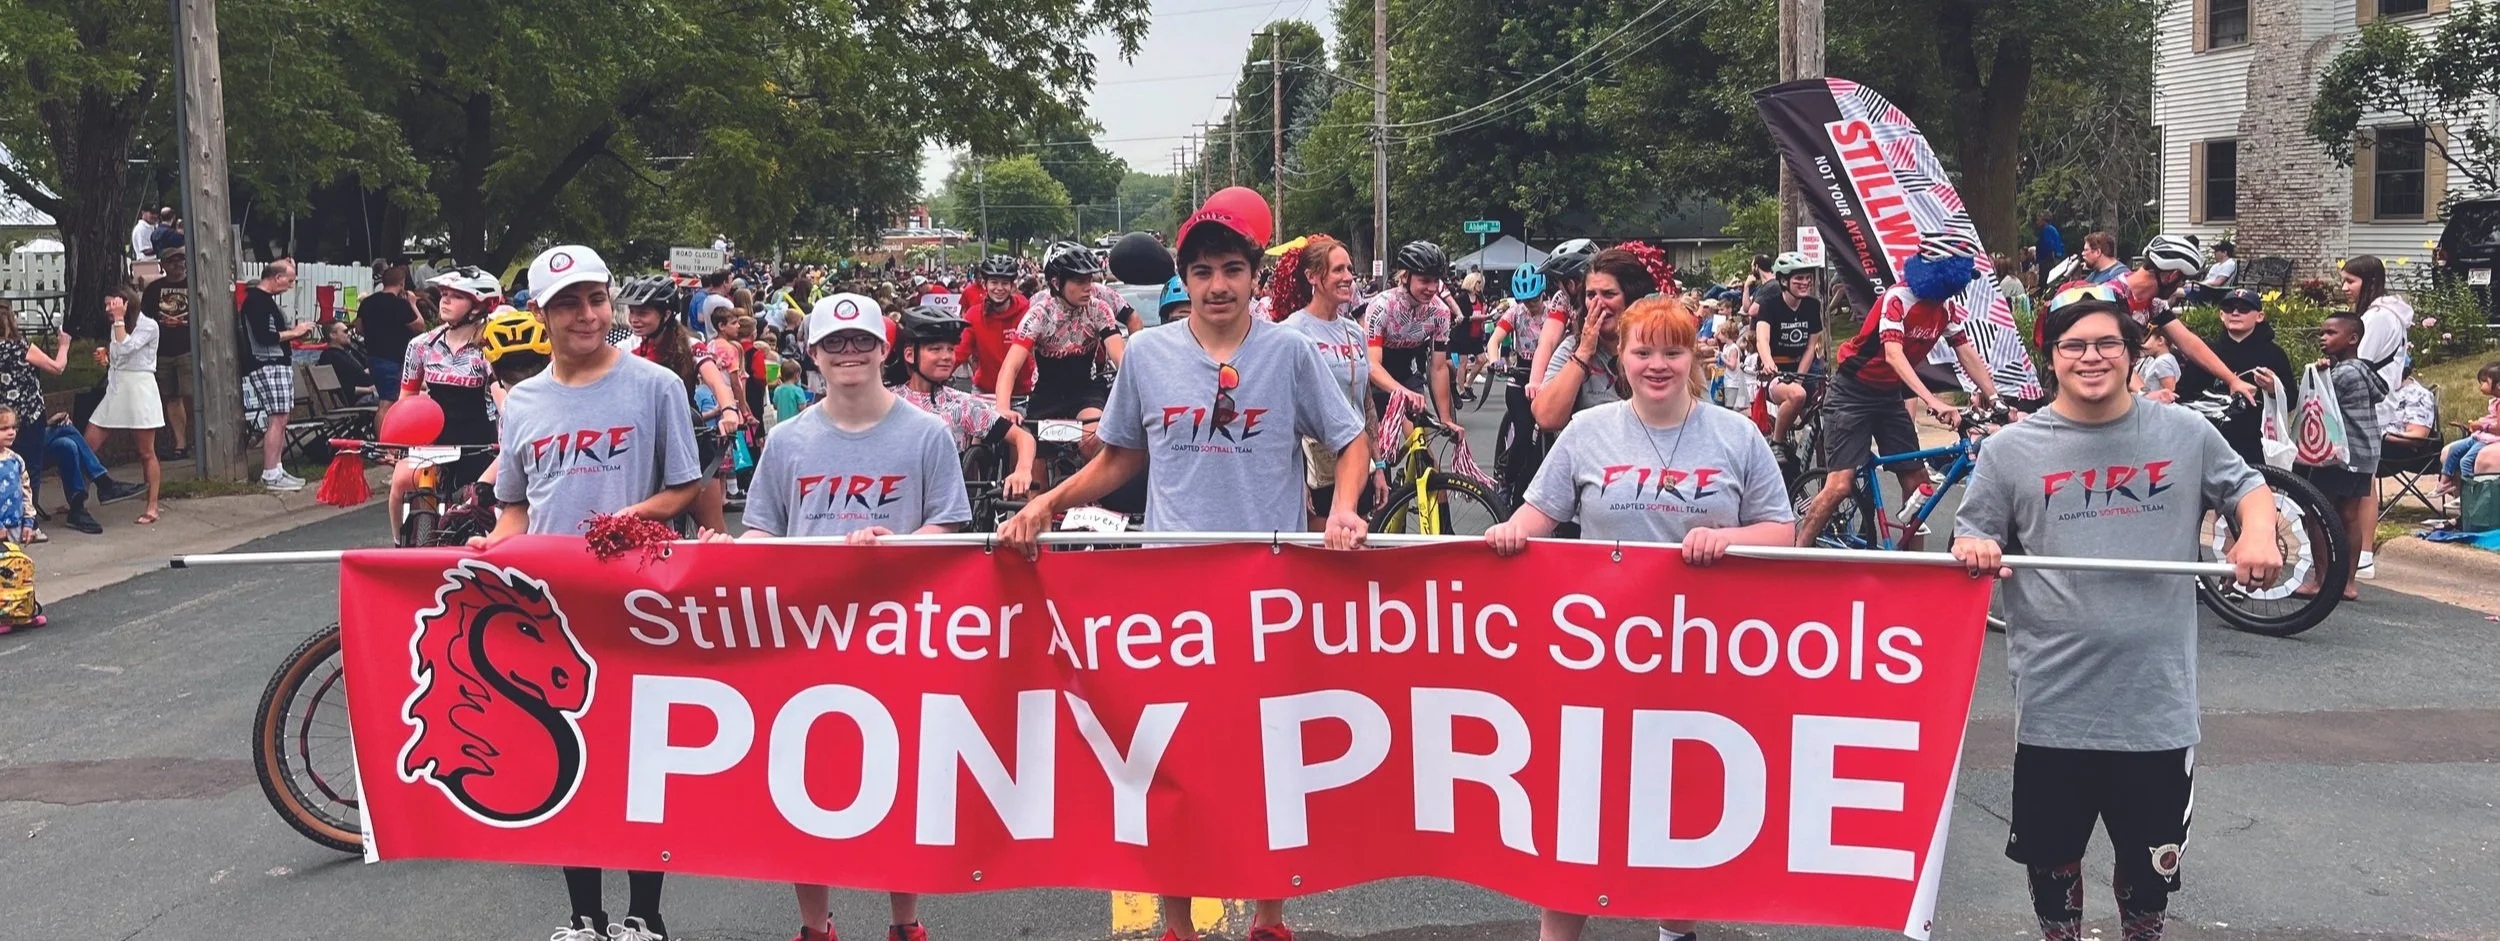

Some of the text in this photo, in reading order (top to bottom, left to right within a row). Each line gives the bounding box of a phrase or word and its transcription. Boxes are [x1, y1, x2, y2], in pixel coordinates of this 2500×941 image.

[1831, 120, 1922, 274] STILLWA
[1814, 155, 1887, 295] NOT YOUR AVERAGE PO
[694, 251, 719, 259] CLOSED
[934, 296, 949, 304] GO
[426, 371, 484, 388] TILLWATER
[1162, 406, 1269, 444] FIRE
[531, 426, 635, 473] FIRE
[1170, 444, 1253, 454] ADAPTED SOFTBALL TEAM
[566, 466, 601, 477] SOFTBALL
[601, 464, 621, 472] TEAM
[1600, 464, 1722, 503] FIRE
[797, 475, 907, 511] FIRE
[1447, 478, 1483, 495] MAXXIS
[2040, 460, 2175, 512] FIRE
[804, 512, 890, 520] ADAPTED SOFTBALL TEAM
[1609, 503, 1708, 514] ADAPTED SOFTBALL TEAM
[2058, 504, 2164, 521] ADAPTED SOFTBALL TEAM
[623, 580, 1923, 684] Stillwater Area Public Schools
[625, 674, 1921, 882] PONY PRIDE
